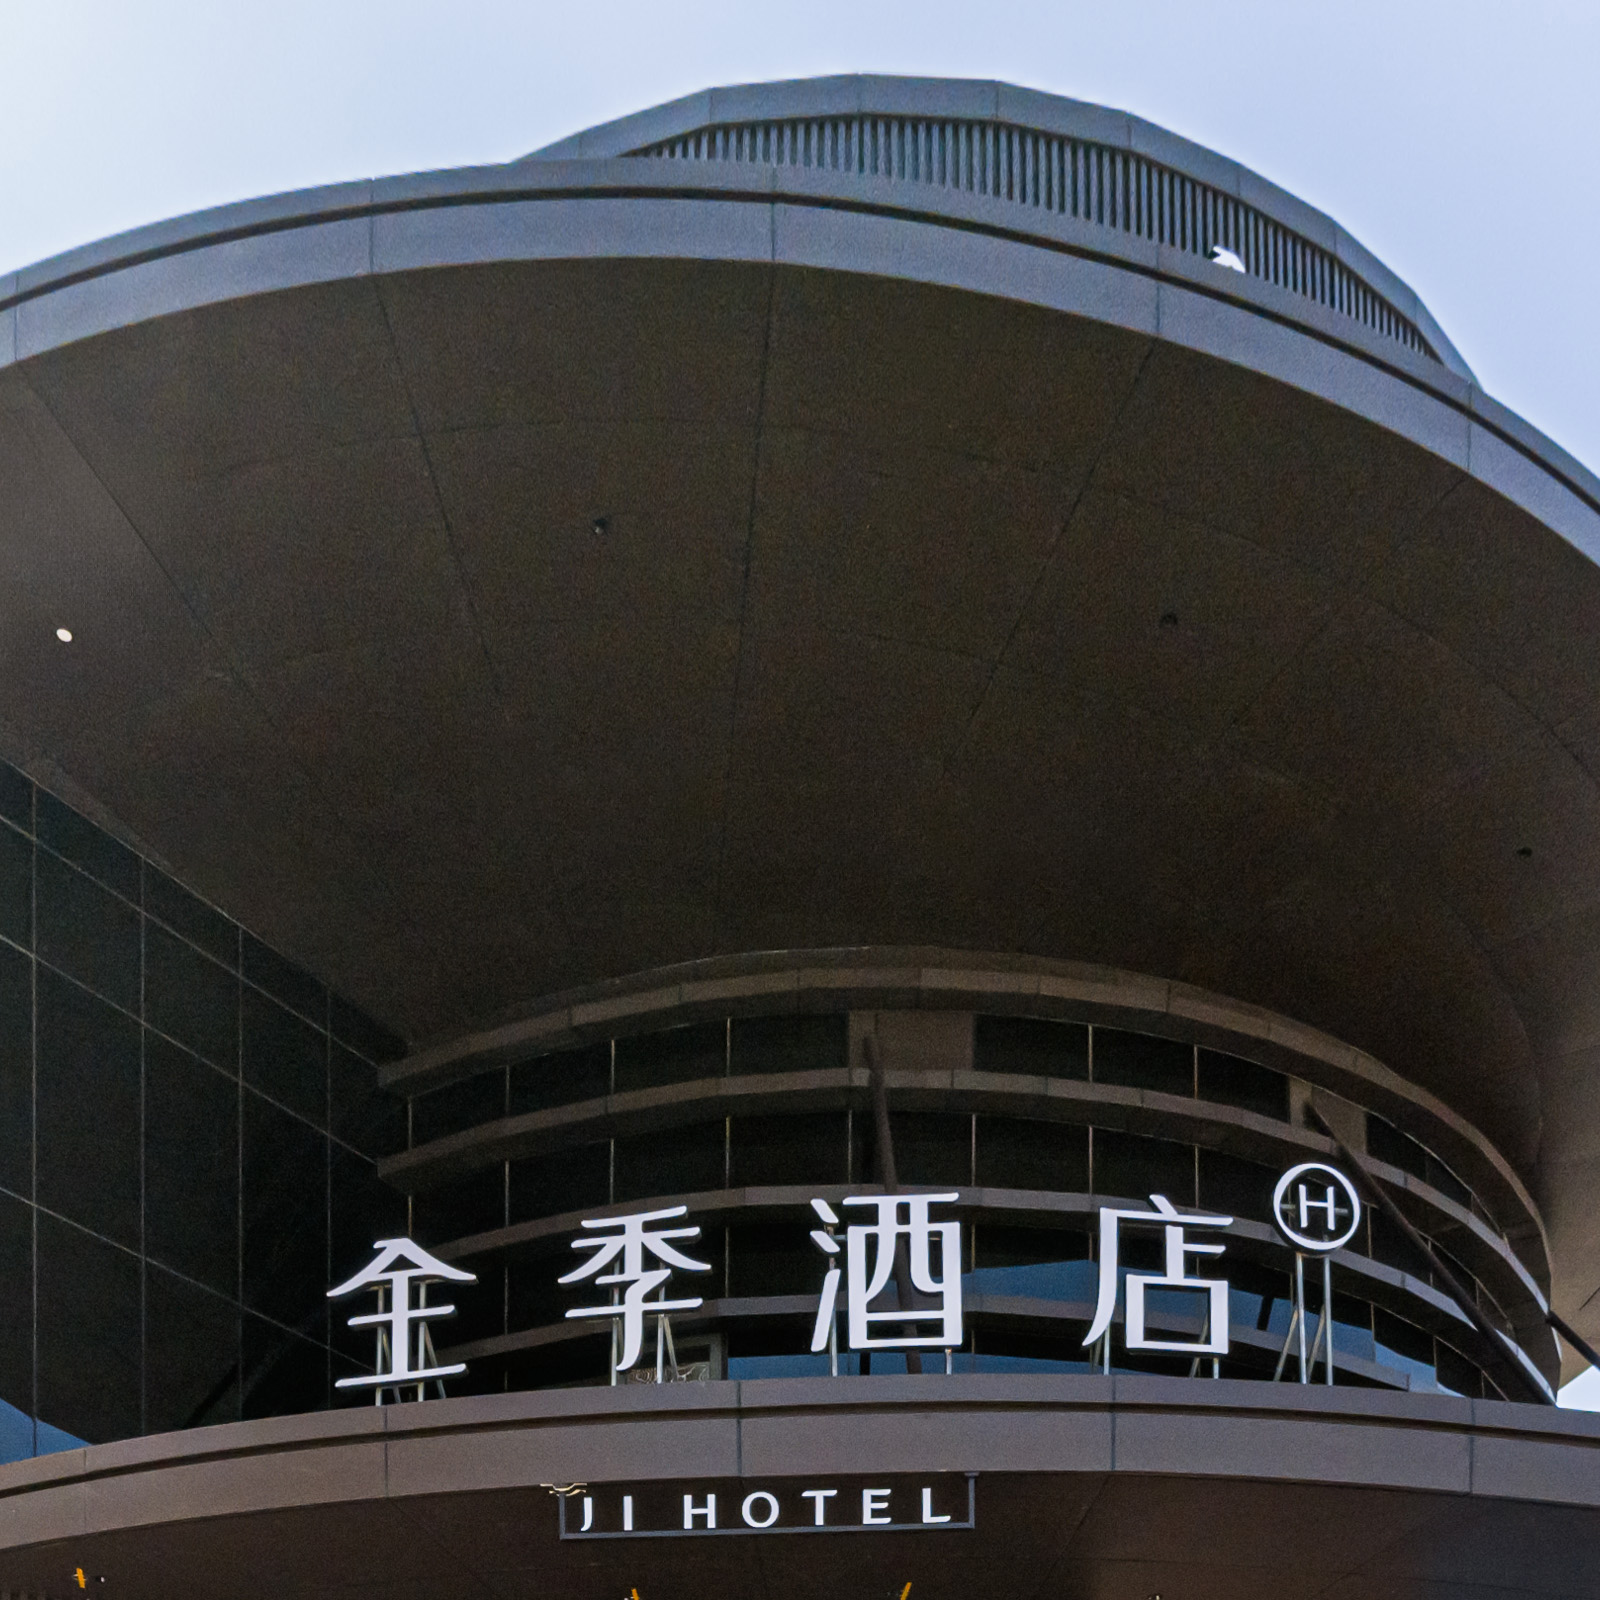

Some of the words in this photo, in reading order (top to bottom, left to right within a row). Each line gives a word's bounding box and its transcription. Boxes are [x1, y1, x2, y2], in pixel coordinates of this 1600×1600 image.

[327, 1191, 1234, 1387] 全季酒店
[581, 1495, 633, 1532] JI
[682, 1487, 951, 1531] HOTEL
